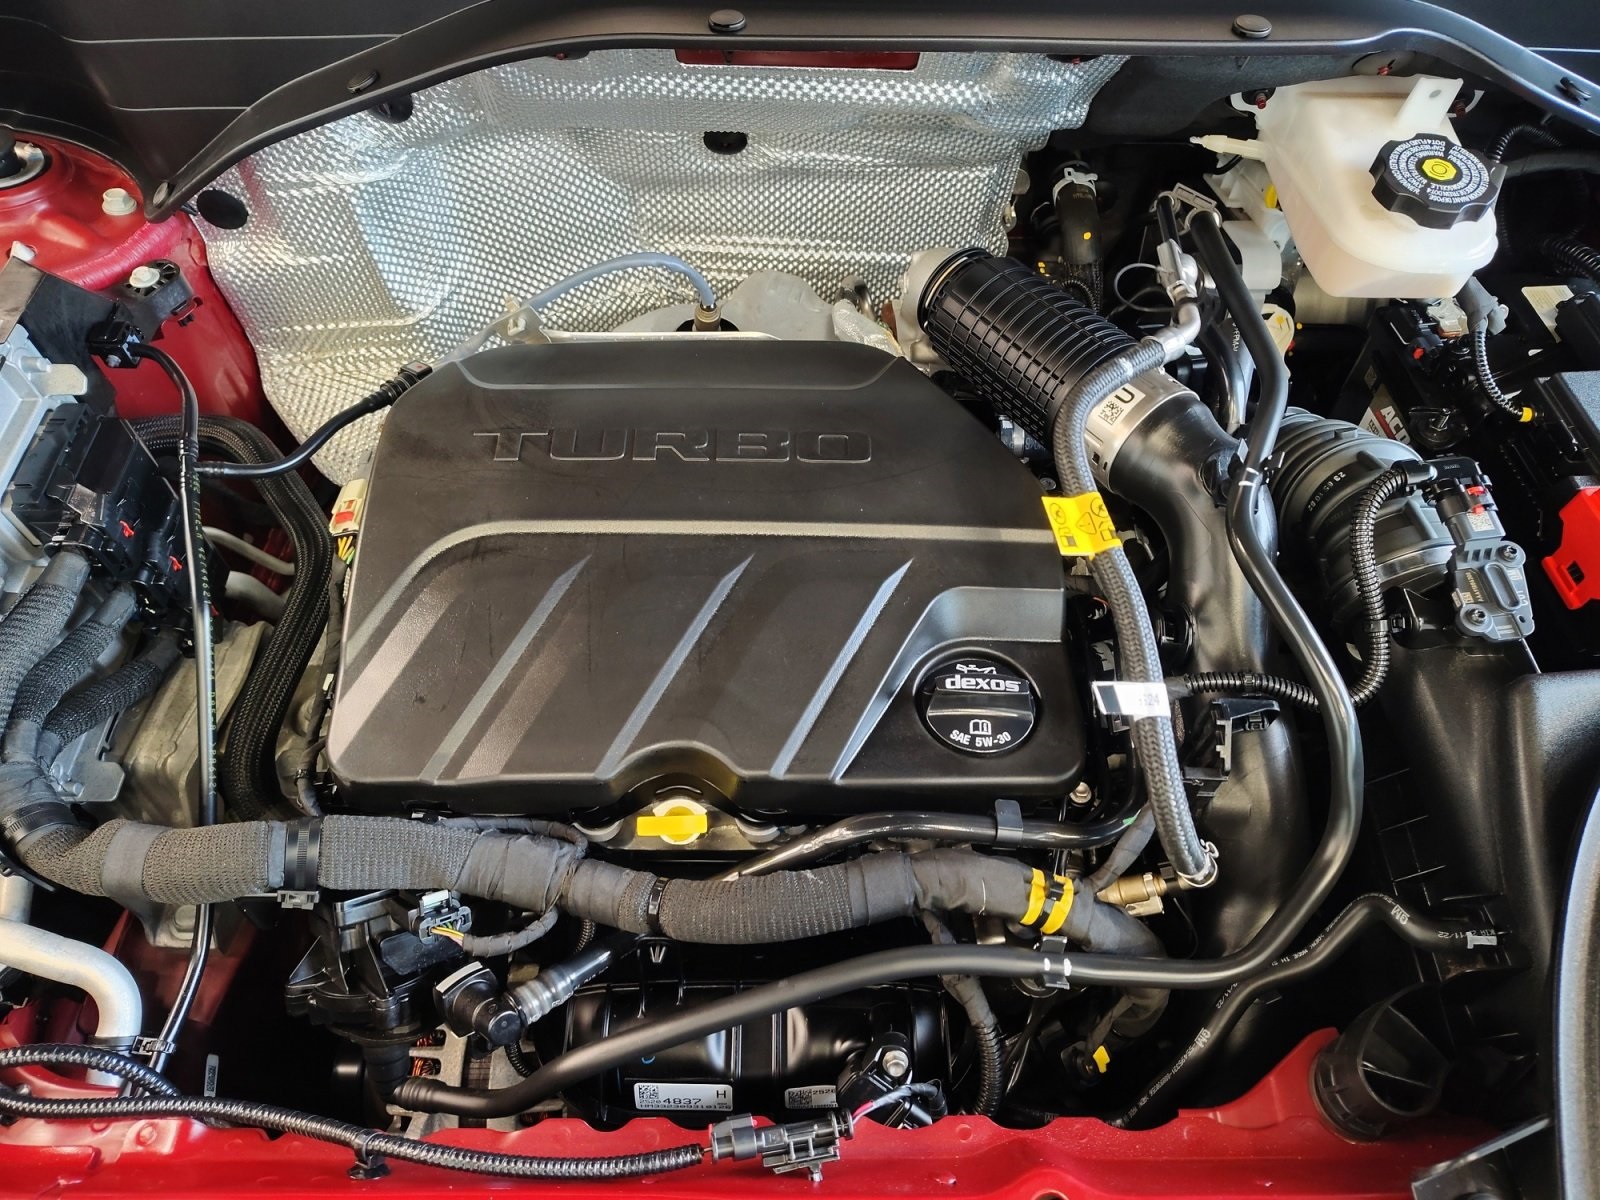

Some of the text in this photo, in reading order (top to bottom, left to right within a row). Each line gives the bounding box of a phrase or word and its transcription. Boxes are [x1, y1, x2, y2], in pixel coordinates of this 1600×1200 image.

[473, 428, 872, 464] TURBO
[945, 674, 1021, 692] dexos
[950, 729, 1011, 747] SAE 5W-30
[1390, 904, 1411, 925] GM
[1193, 1027, 1212, 1048] GM
[715, 1089, 727, 1099] H
